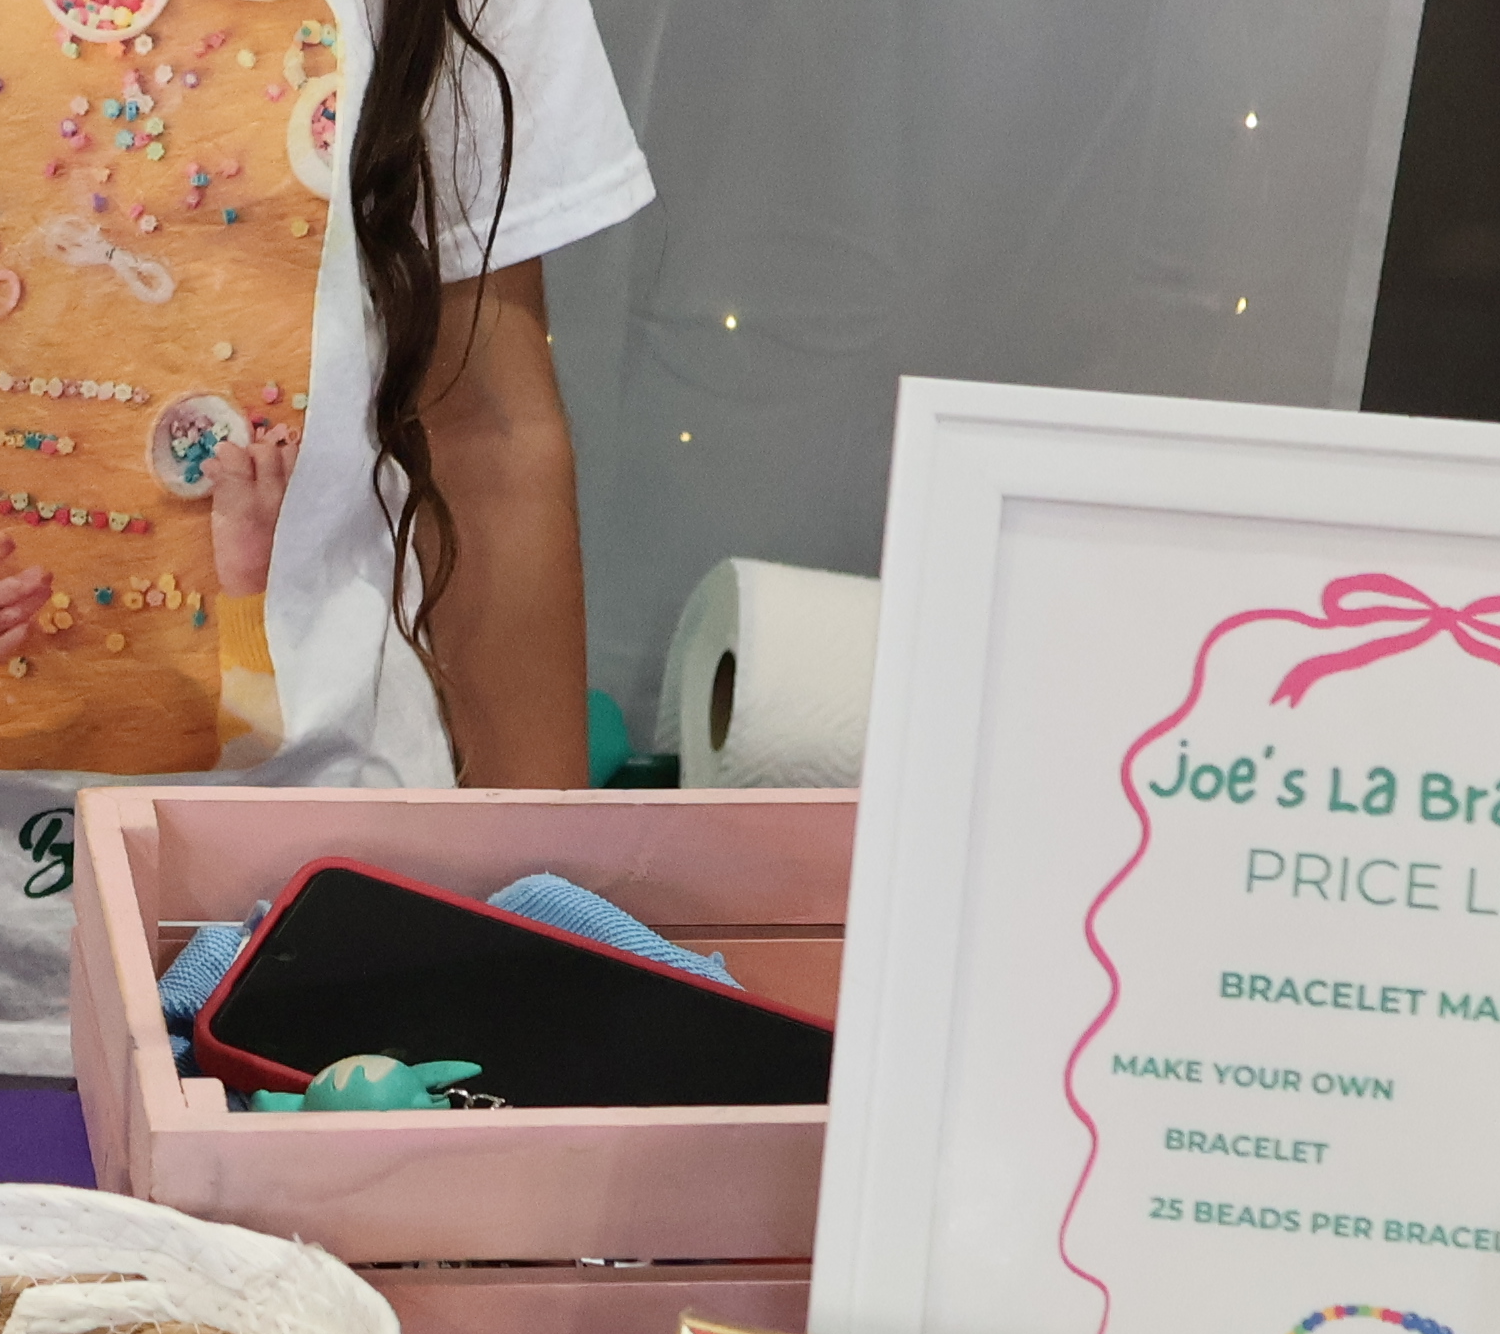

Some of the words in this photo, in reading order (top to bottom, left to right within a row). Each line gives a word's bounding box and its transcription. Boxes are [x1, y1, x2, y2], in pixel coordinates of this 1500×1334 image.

[1328, 766, 1397, 817] La
[1246, 847, 1442, 912] PRICE
[1219, 971, 1427, 1016] BRACELET
[1111, 1053, 1202, 1083] MAKE
[1213, 1063, 1302, 1093] YOUR
[1311, 1072, 1395, 1101] OWN
[1164, 1128, 1330, 1165] BRACELET
[1149, 1196, 1184, 1222] 25
[1194, 1200, 1302, 1233] BEADS
[1310, 1212, 1373, 1240] PER
